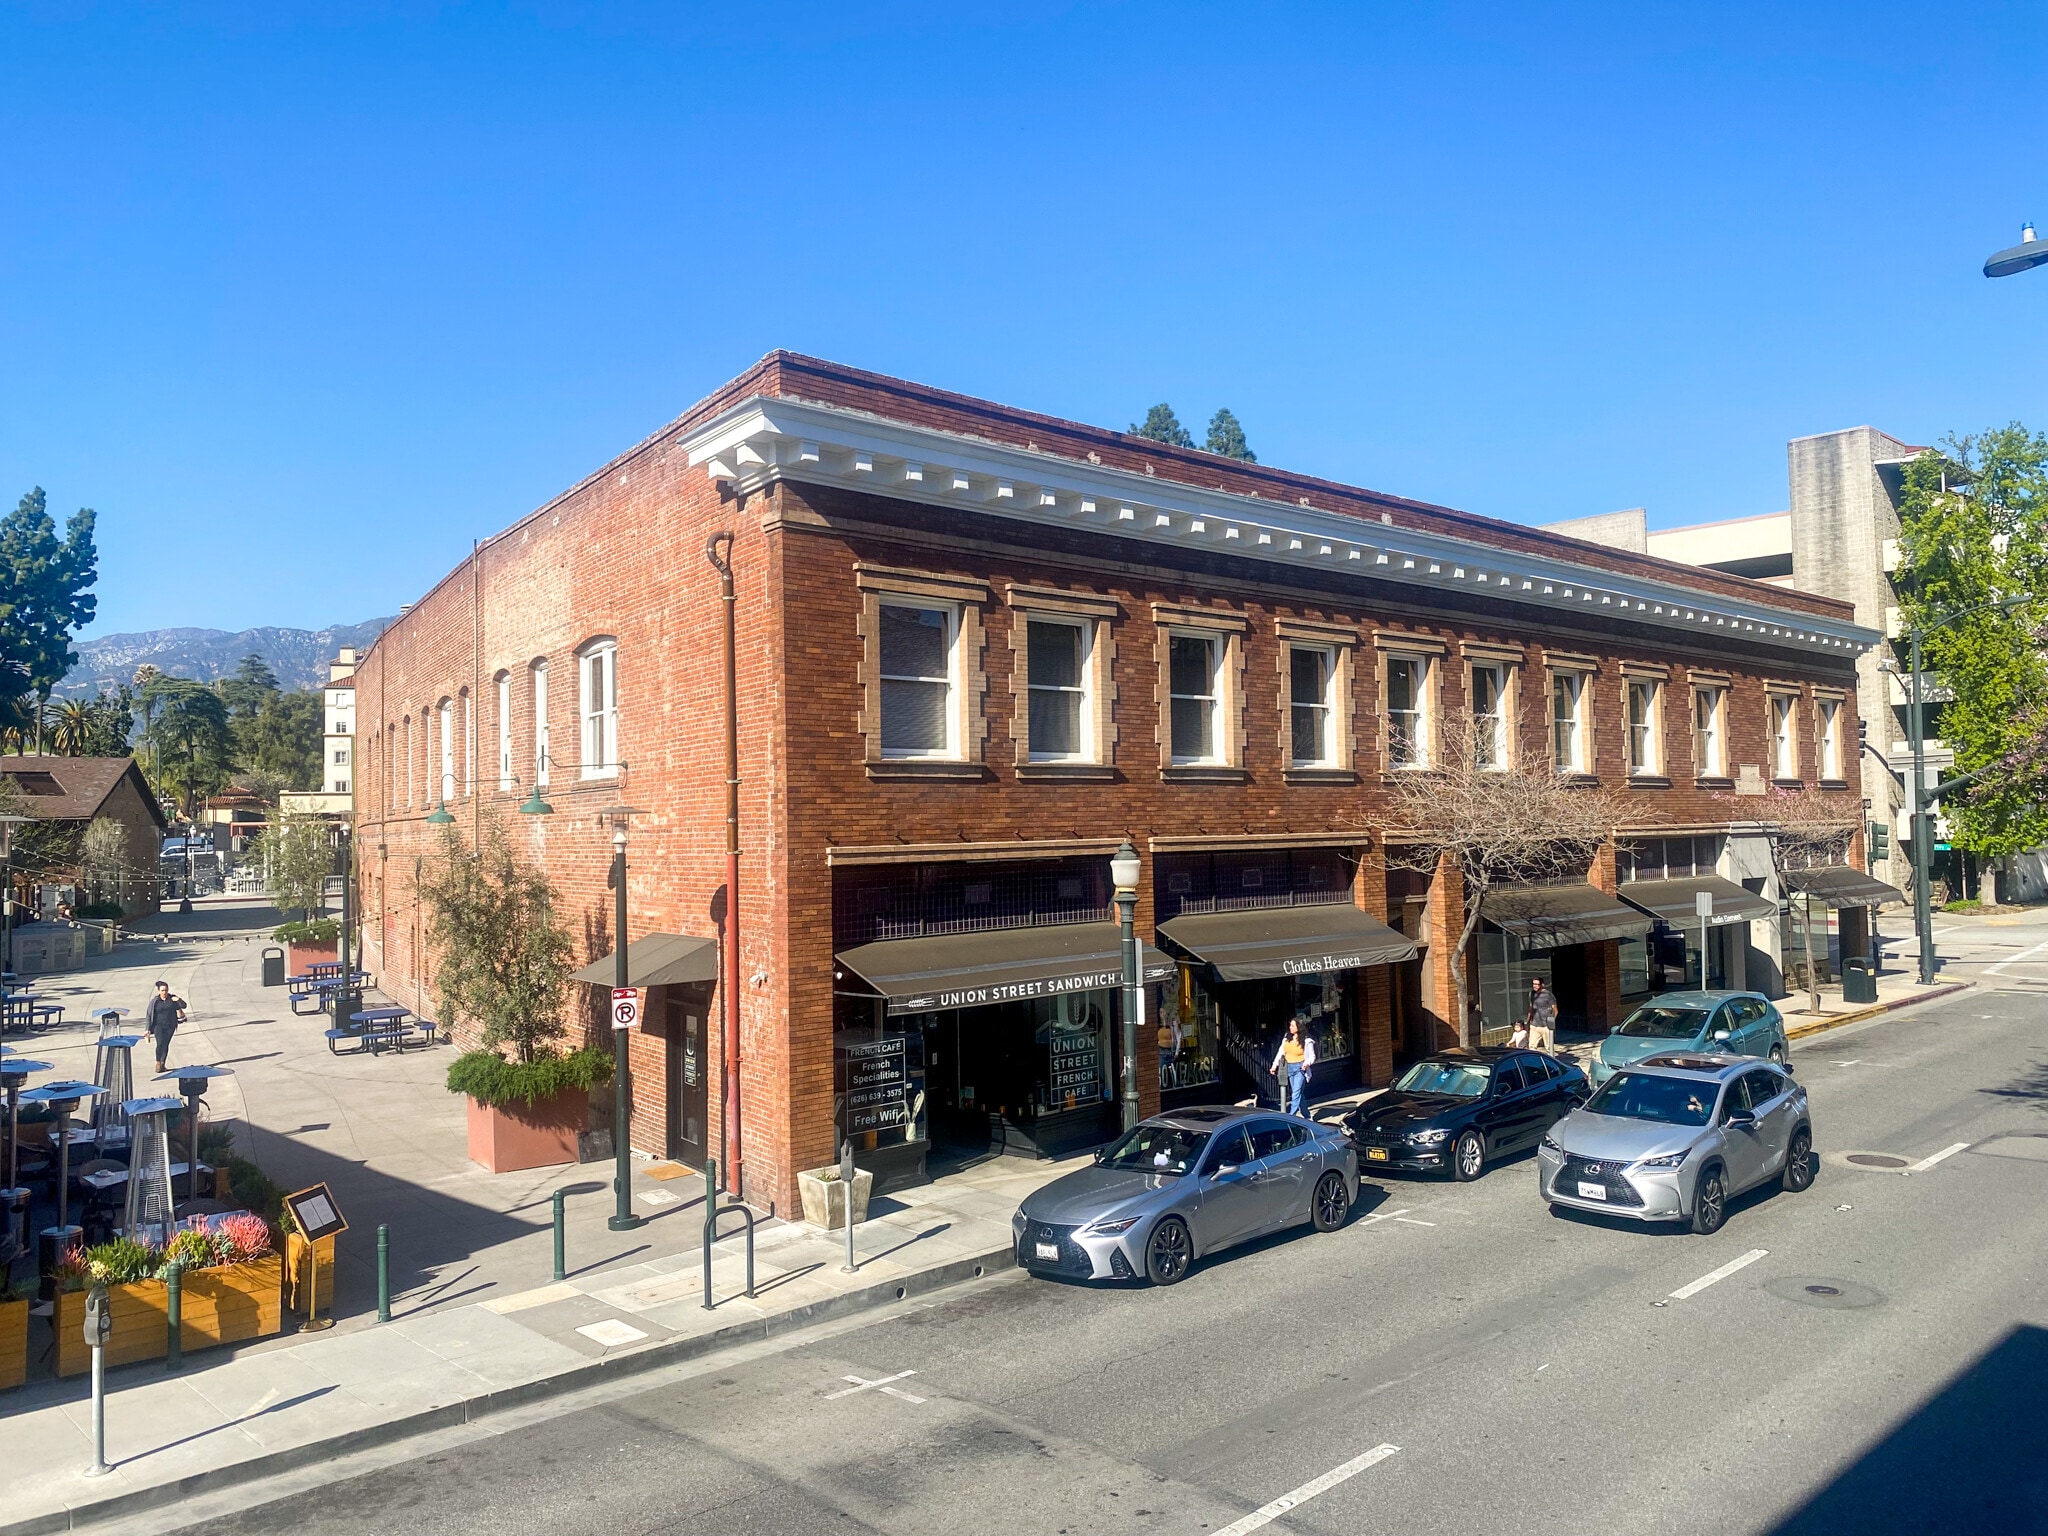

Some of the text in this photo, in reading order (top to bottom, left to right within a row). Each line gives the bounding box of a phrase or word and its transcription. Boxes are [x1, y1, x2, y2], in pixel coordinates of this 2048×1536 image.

[1283, 956, 1361, 974] Clothes Heaven
[940, 990, 987, 1006] UNION
[992, 982, 1042, 1000] STREET
[1048, 973, 1116, 992] SANDWICH
[850, 1045, 881, 1057] FRENCH
[1053, 1036, 1096, 1053] UNION
[862, 1059, 891, 1072] French
[1053, 1054, 1096, 1070] STREET
[853, 1069, 900, 1085] Specialities
[1057, 1071, 1094, 1085] FRENCH
[886, 1088, 903, 1098] 3575
[854, 1115, 877, 1127] Free
